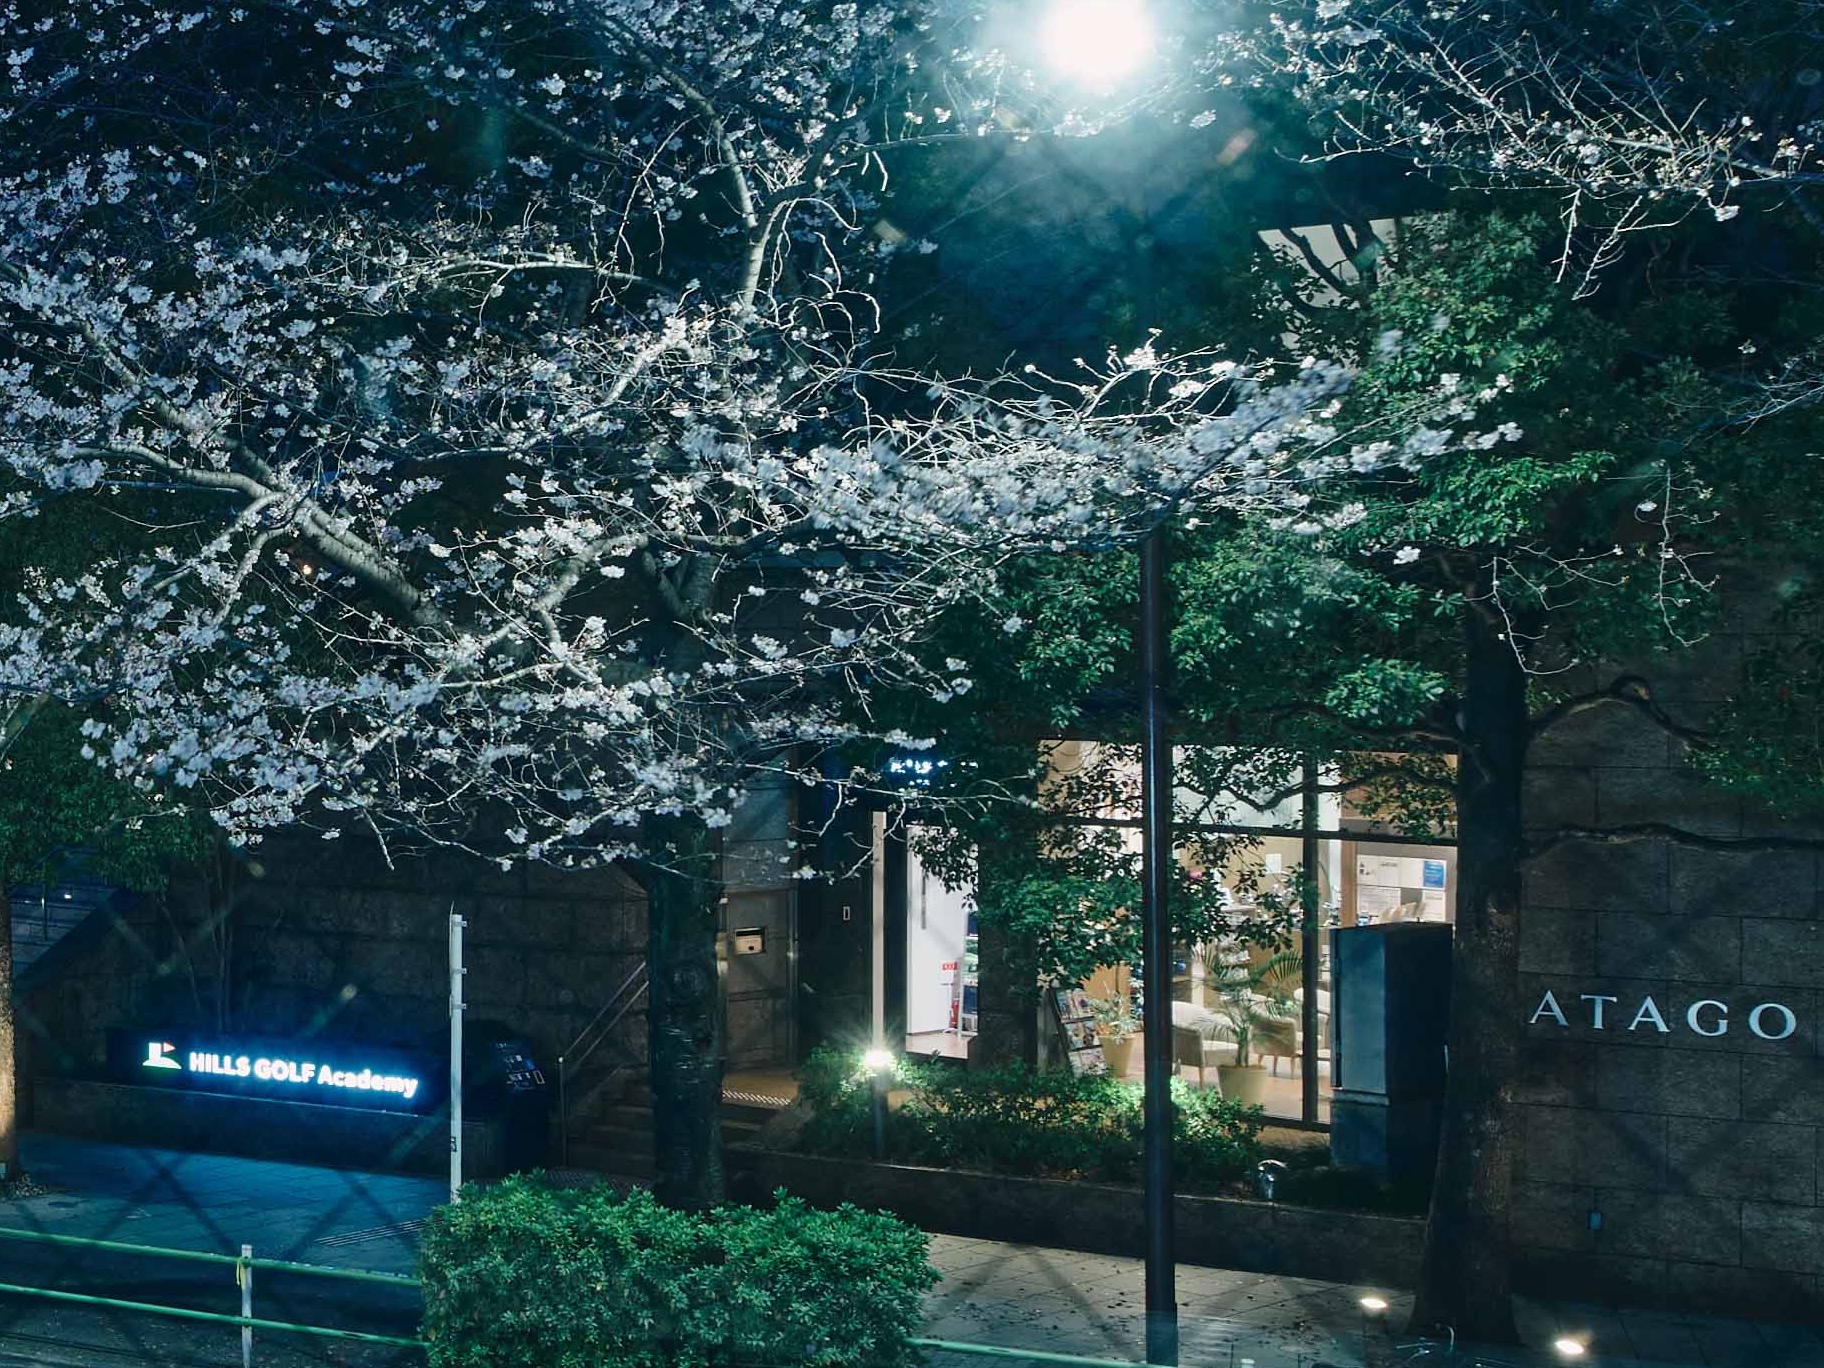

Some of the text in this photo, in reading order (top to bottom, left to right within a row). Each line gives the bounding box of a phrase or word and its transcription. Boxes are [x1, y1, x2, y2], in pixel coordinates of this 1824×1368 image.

[1529, 989, 1798, 1040] ATAGO
[188, 1051, 419, 1099] HILLS GOLF Academy
